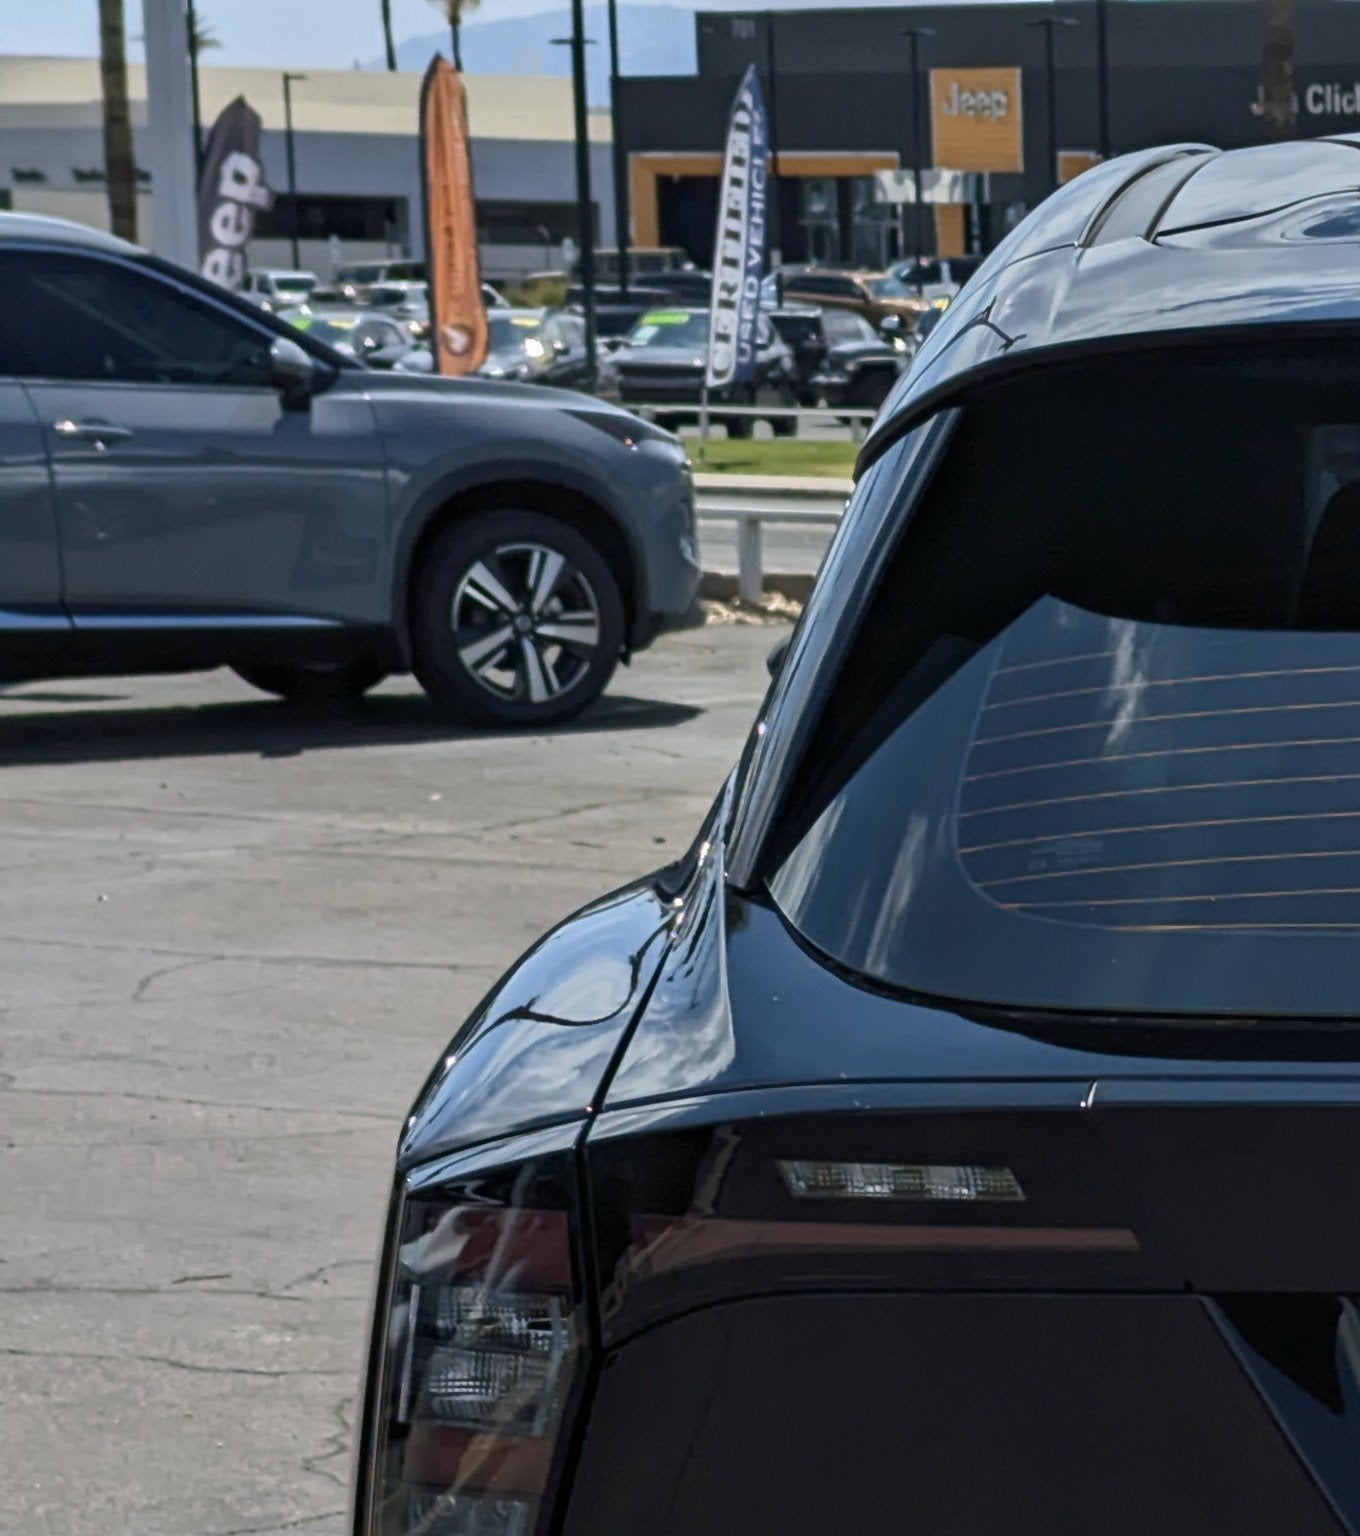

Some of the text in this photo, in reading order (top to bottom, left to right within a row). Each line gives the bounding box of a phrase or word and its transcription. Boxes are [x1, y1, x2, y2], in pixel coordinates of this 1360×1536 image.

[943, 82, 1007, 122] Jeep
[201, 152, 274, 291] eep
[711, 88, 751, 378] CERTIFIED
[738, 278, 759, 363] USED
